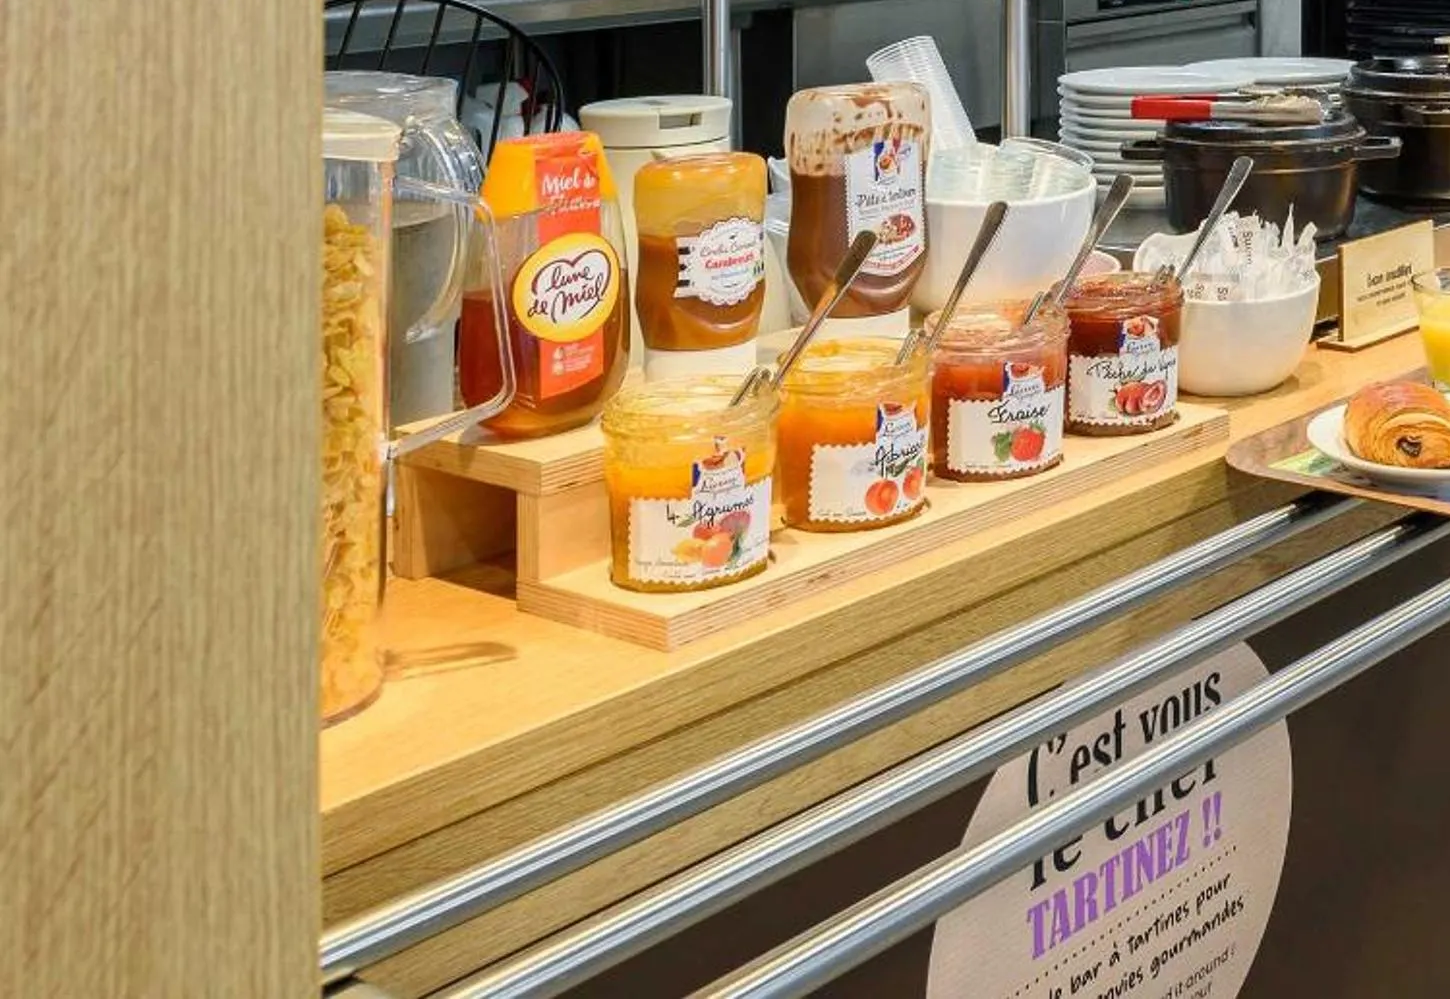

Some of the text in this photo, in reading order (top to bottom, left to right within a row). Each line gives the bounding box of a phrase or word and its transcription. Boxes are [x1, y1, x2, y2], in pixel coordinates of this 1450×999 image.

[542, 170, 580, 197] Miel
[527, 271, 606, 323] de miel
[546, 265, 594, 293] lune
[987, 401, 1052, 425] Fraise
[1139, 671, 1222, 744] vous
[1026, 790, 1224, 961] TARTINEZ !!
[1069, 960, 1103, 995] bar
[1109, 941, 1121, 967] à
[1126, 900, 1191, 957] tartines
[1195, 872, 1232, 916] pour
[1150, 894, 1246, 979] gourmandes
